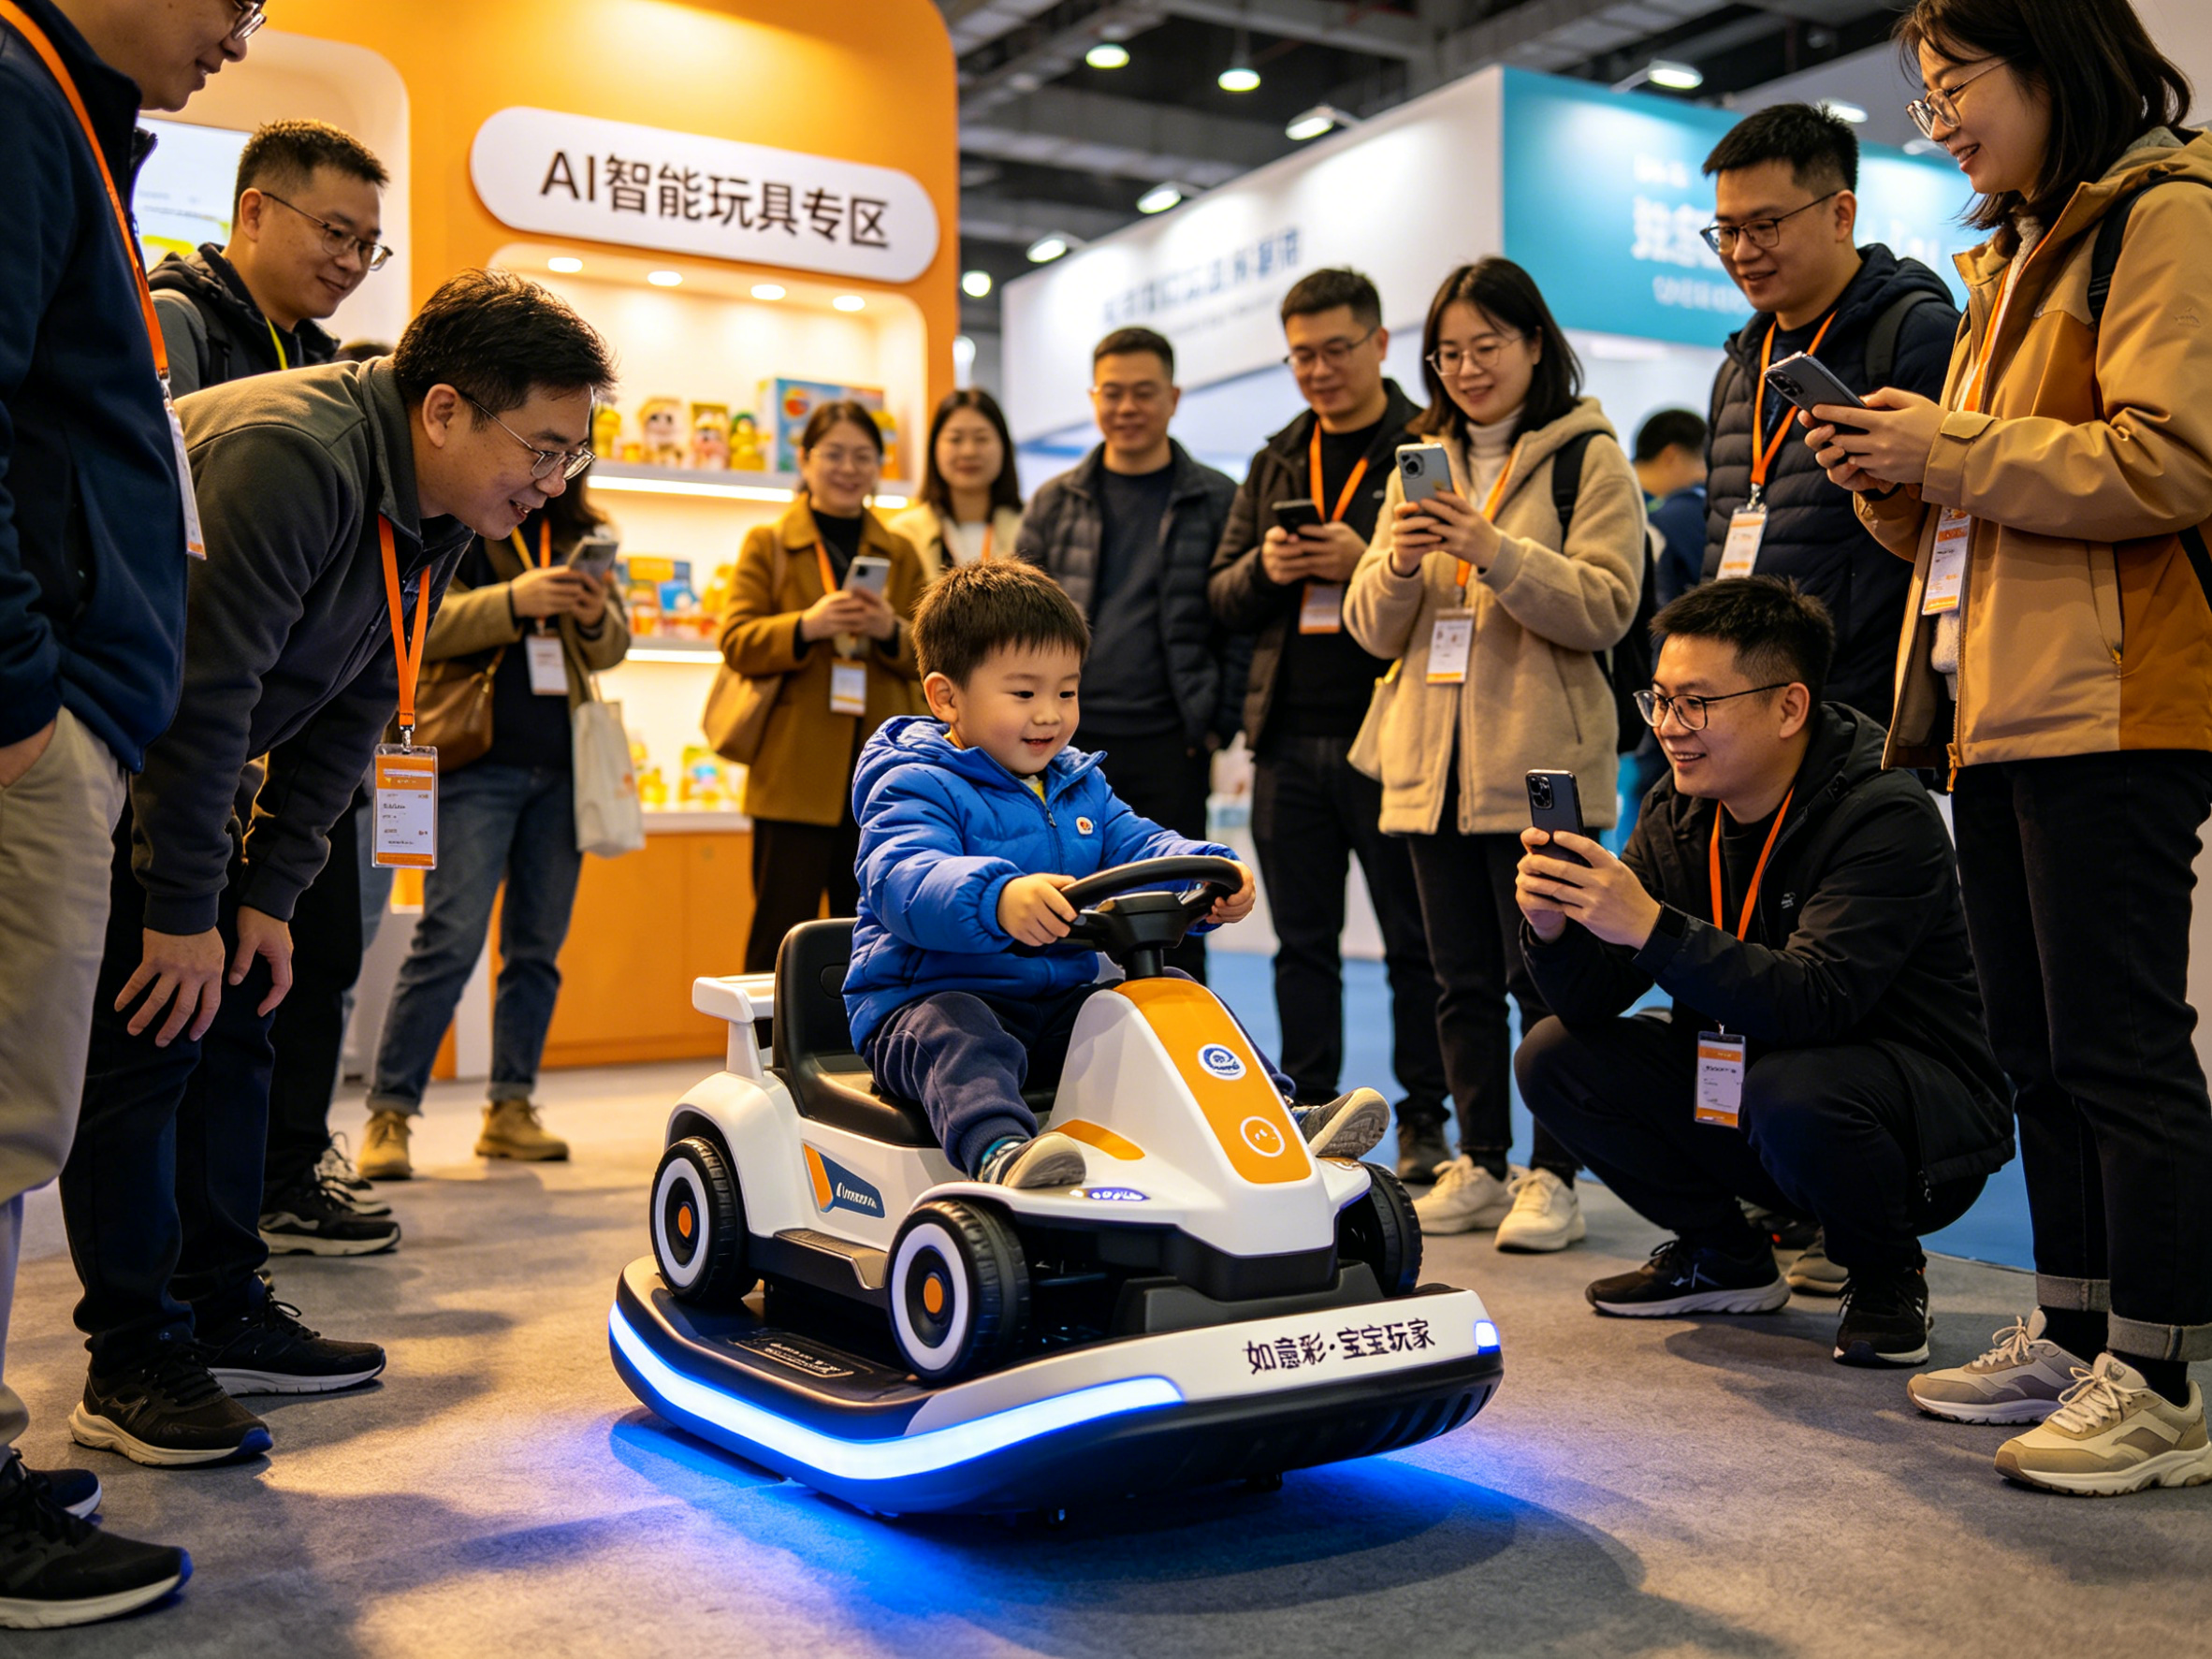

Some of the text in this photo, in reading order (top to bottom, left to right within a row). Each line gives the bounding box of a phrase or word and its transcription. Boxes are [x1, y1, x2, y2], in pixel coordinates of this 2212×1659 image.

[541, 151, 890, 248] AI智能玩具专区
